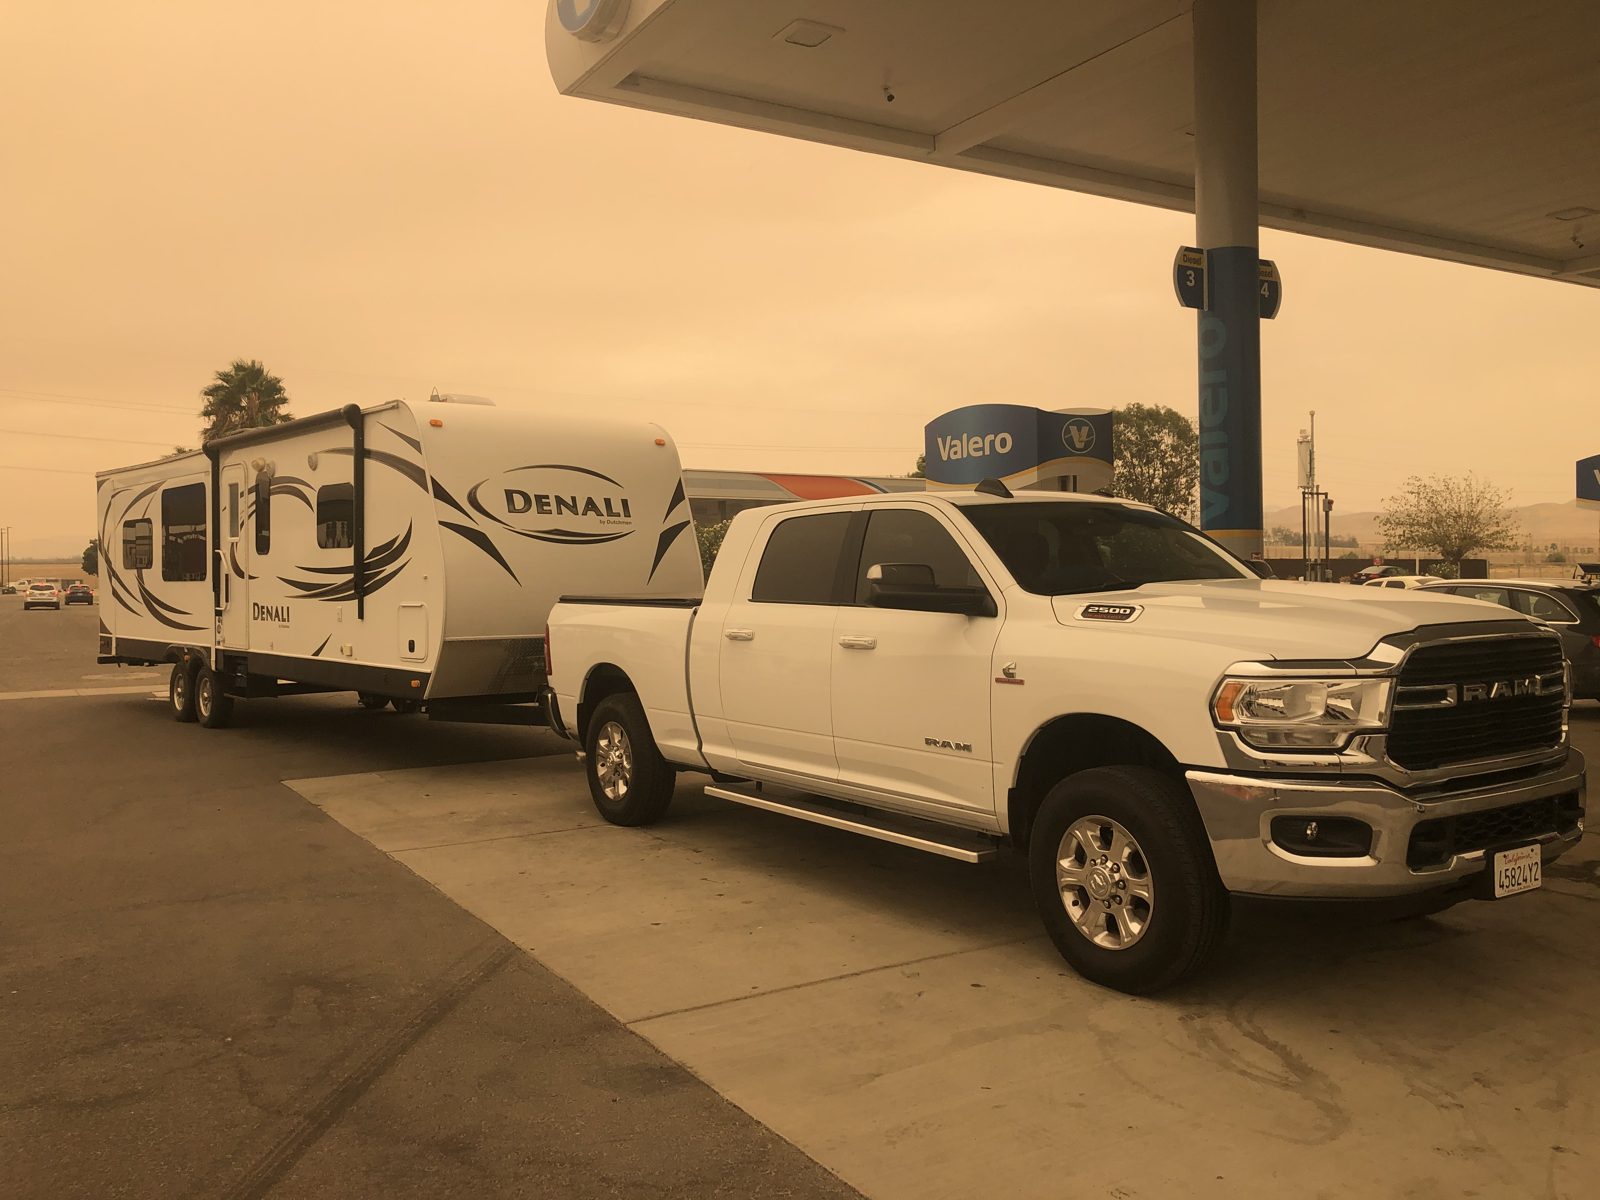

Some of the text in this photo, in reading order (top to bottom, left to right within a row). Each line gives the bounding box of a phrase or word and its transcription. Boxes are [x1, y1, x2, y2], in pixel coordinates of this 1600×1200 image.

[1186, 270, 1195, 287] 3
[1260, 282, 1270, 298] 4
[937, 432, 1013, 461] Valero
[1088, 606, 1131, 615] 2500
[1463, 679, 1540, 701] RAM
[924, 736, 973, 753] RAM
[1504, 852, 1533, 865] California
[1498, 861, 1540, 891] 45824Y2
